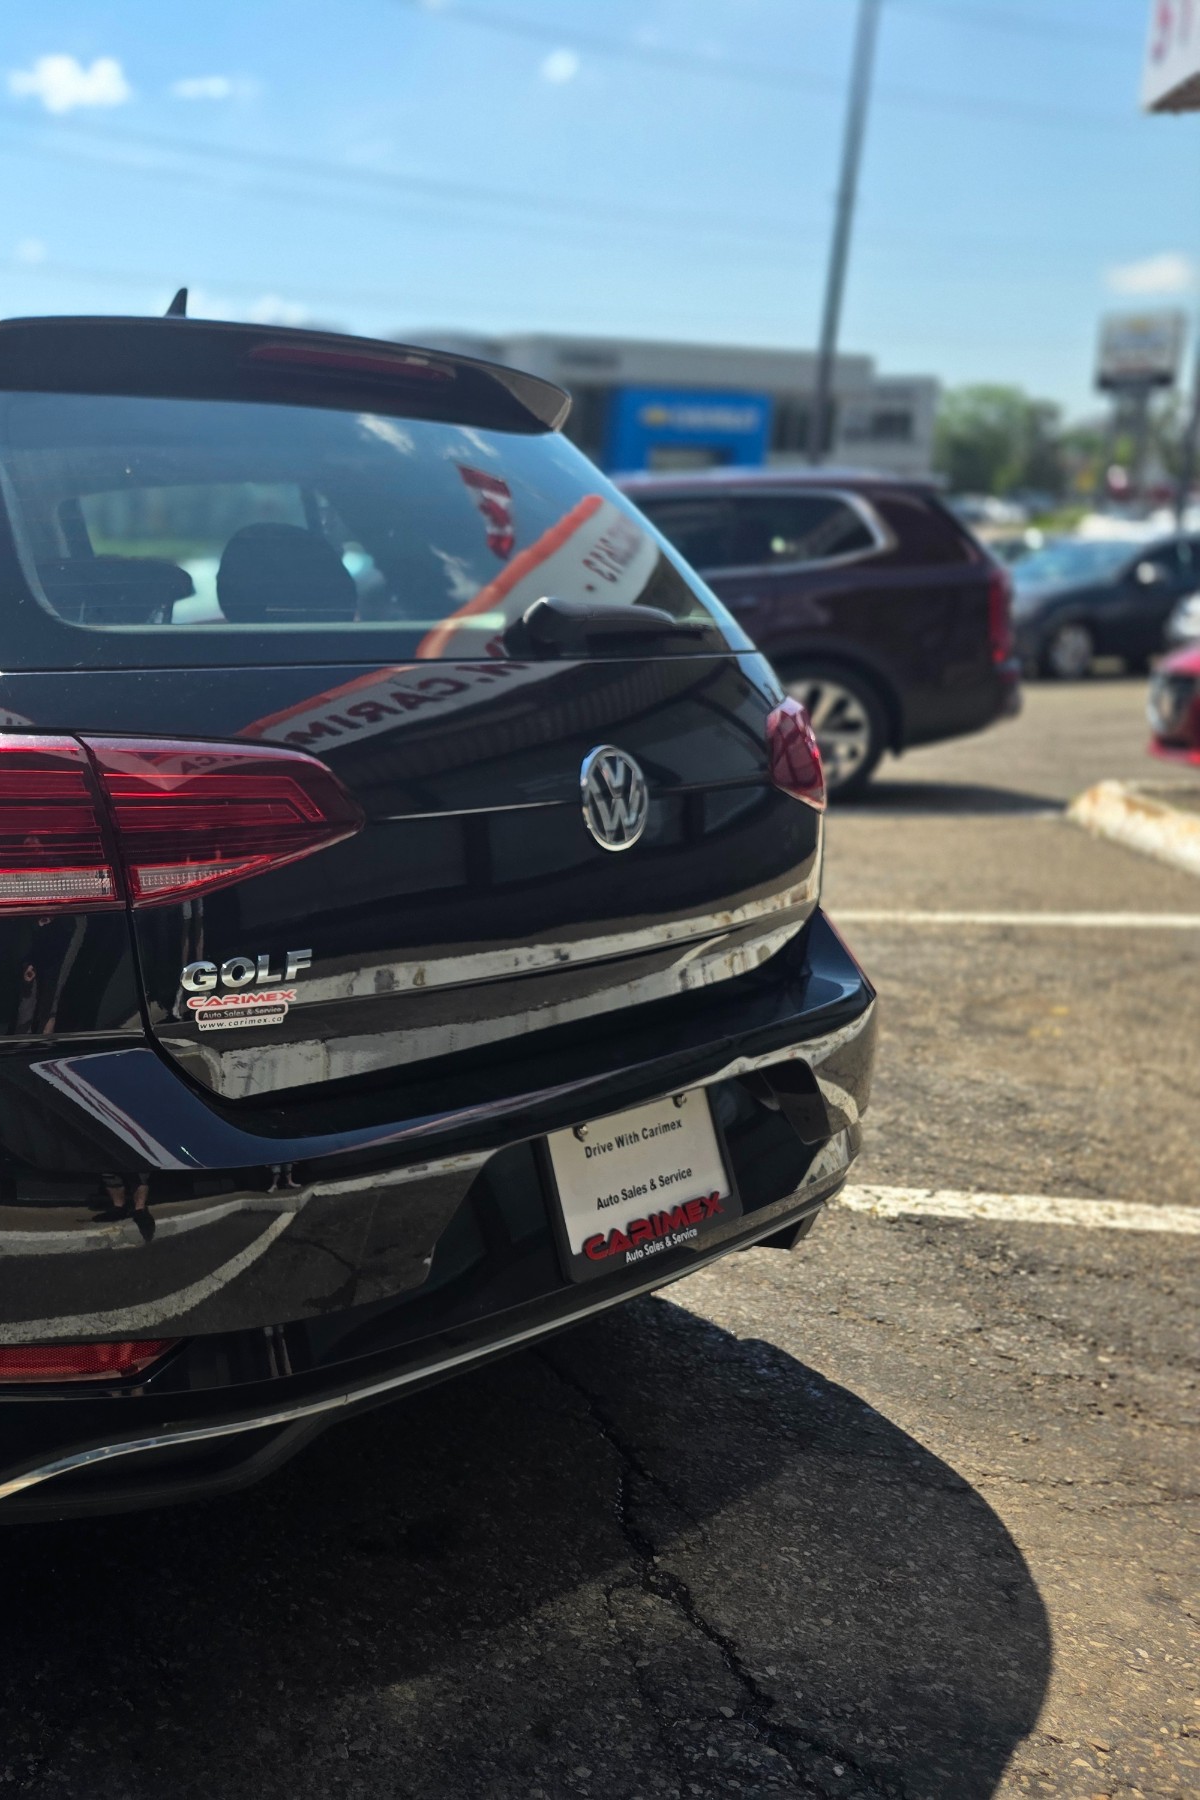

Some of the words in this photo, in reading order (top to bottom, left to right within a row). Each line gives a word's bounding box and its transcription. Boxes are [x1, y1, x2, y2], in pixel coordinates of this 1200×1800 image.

[181, 949, 313, 992] GOLF
[189, 991, 296, 1008] CARIMEX
[202, 1011, 222, 1020] Auto
[223, 1009, 246, 1018] Sales
[254, 1006, 283, 1015] Service
[200, 1015, 283, 1030] www.carimex.ca
[584, 1139, 614, 1159] Drive
[615, 1131, 640, 1150] With
[641, 1118, 683, 1139] Carimex
[596, 1192, 620, 1211] Auto
[621, 1182, 648, 1202] Sales
[649, 1178, 657, 1191] &
[658, 1166, 693, 1187] Service
[583, 1191, 725, 1260] CARIMEX
[625, 1246, 644, 1264] Auto
[644, 1239, 665, 1255] Sales
[665, 1236, 672, 1248] &
[672, 1227, 698, 1244] Service
